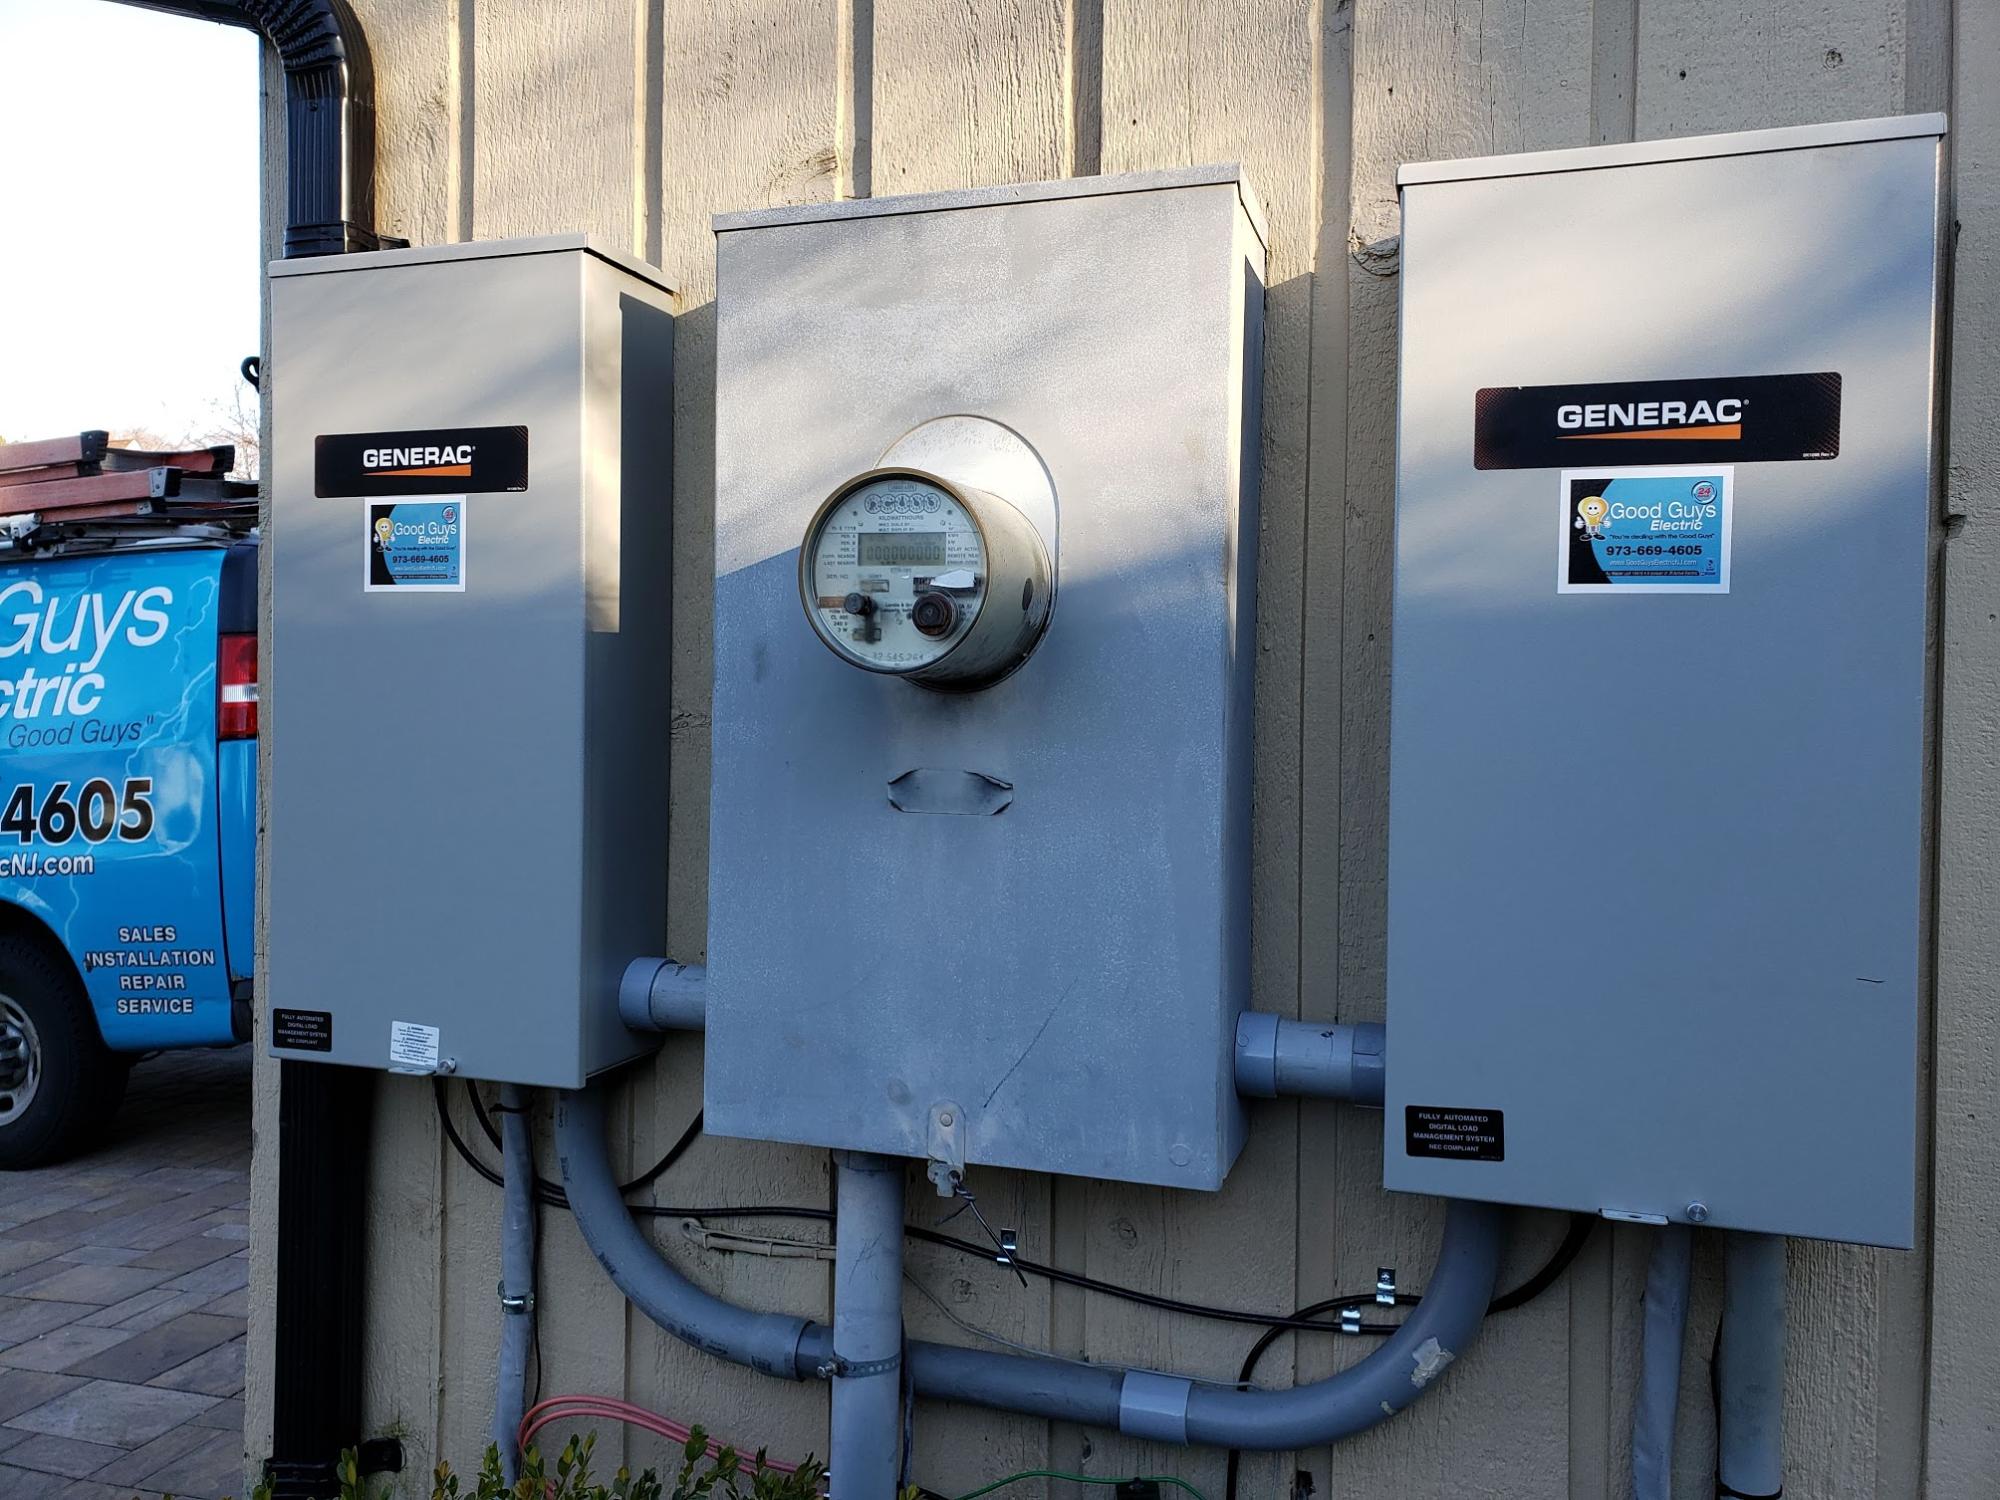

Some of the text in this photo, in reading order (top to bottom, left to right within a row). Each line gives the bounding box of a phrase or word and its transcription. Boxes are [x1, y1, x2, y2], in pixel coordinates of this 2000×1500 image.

[1557, 398, 1742, 429] GENERAC
[363, 445, 472, 468] GENERAC
[1698, 487, 1711, 495] 24
[1610, 501, 1717, 522] Good Guys
[394, 521, 457, 537] Good Guys
[1650, 519, 1703, 531] Electric
[418, 536, 449, 545] Electric
[1606, 545, 1702, 556] 973-669-4605
[392, 555, 449, 564] 973-669-4605
[0, 580, 173, 674] Guys
[9, 721, 76, 748] Good
[0, 776, 155, 847] 4605
[119, 926, 176, 942] SALES
[86, 950, 215, 967] INSTALLATION
[120, 975, 185, 990] REPAIR
[117, 998, 193, 1014] SERVICE
[1418, 1112, 1489, 1123] FULLY AUTOMATED
[1429, 1123, 1478, 1132] DIGITAL LOAD
[1413, 1132, 1495, 1143] MANAGEMENT SYSTEM
[1443, 1144, 1479, 1152] COMPLIANT
